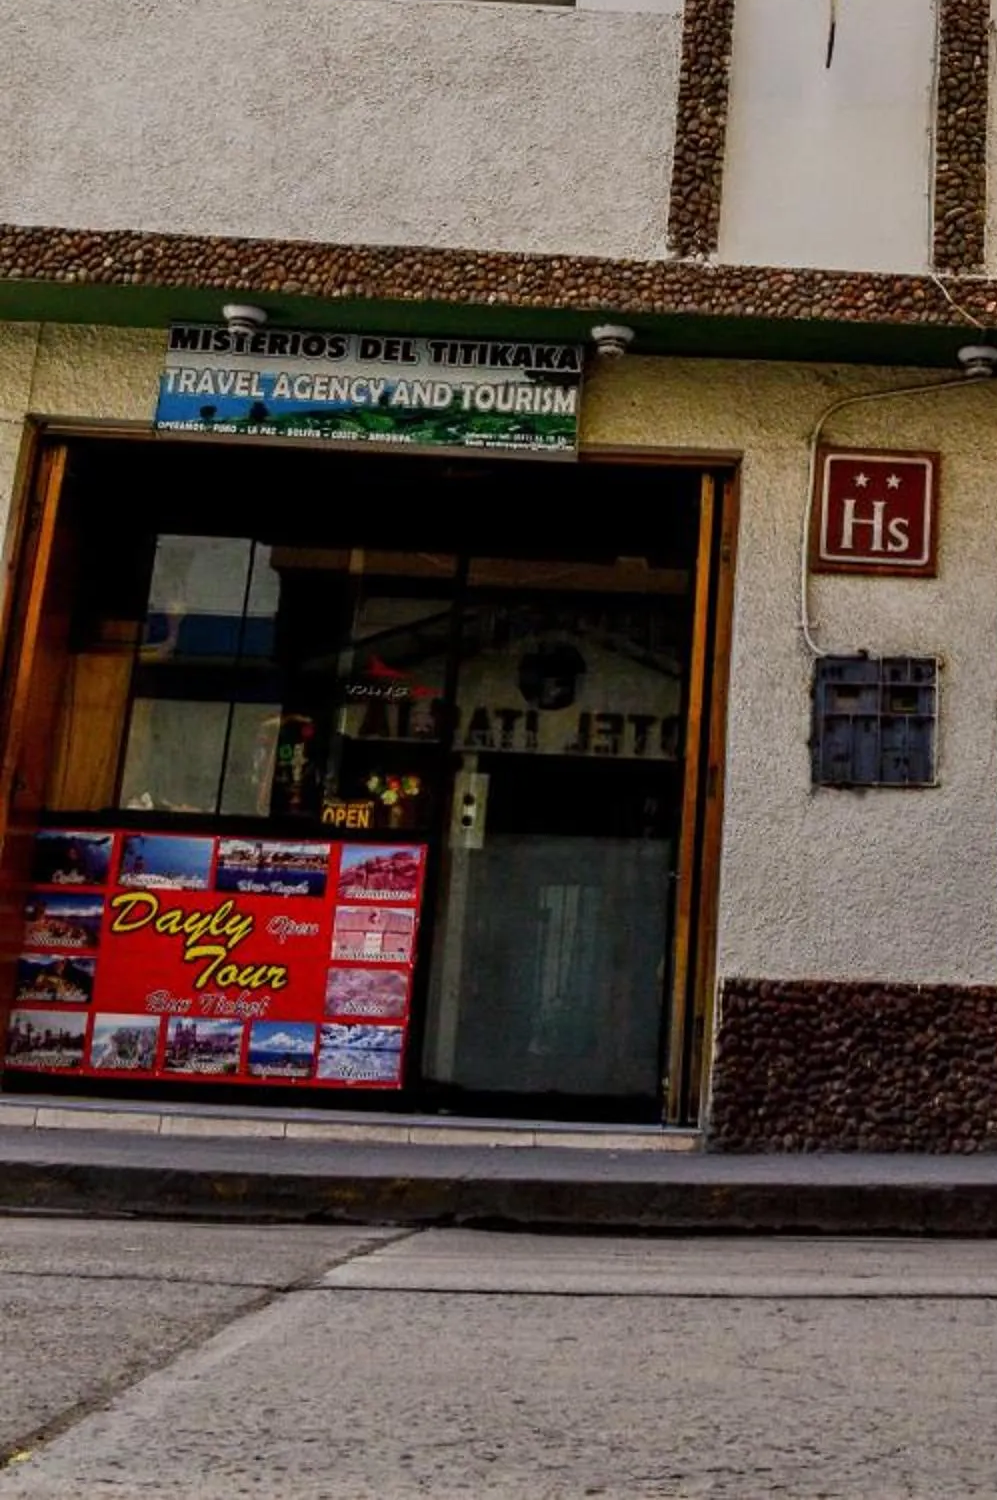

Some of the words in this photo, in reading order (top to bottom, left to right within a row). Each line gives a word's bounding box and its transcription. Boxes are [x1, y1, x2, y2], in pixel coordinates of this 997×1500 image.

[169, 326, 348, 360] MISTERIOS
[358, 337, 417, 363] DEL
[428, 341, 580, 372] TITIKAKA
[165, 367, 265, 398] TRAVEL
[271, 372, 386, 407] AGENCY
[391, 380, 453, 409] AND
[460, 384, 577, 416] TOURISM
[840, 499, 910, 553] Hs
[322, 807, 369, 829] OPEN
[111, 891, 254, 948] Dayly
[184, 945, 288, 990] Tour
